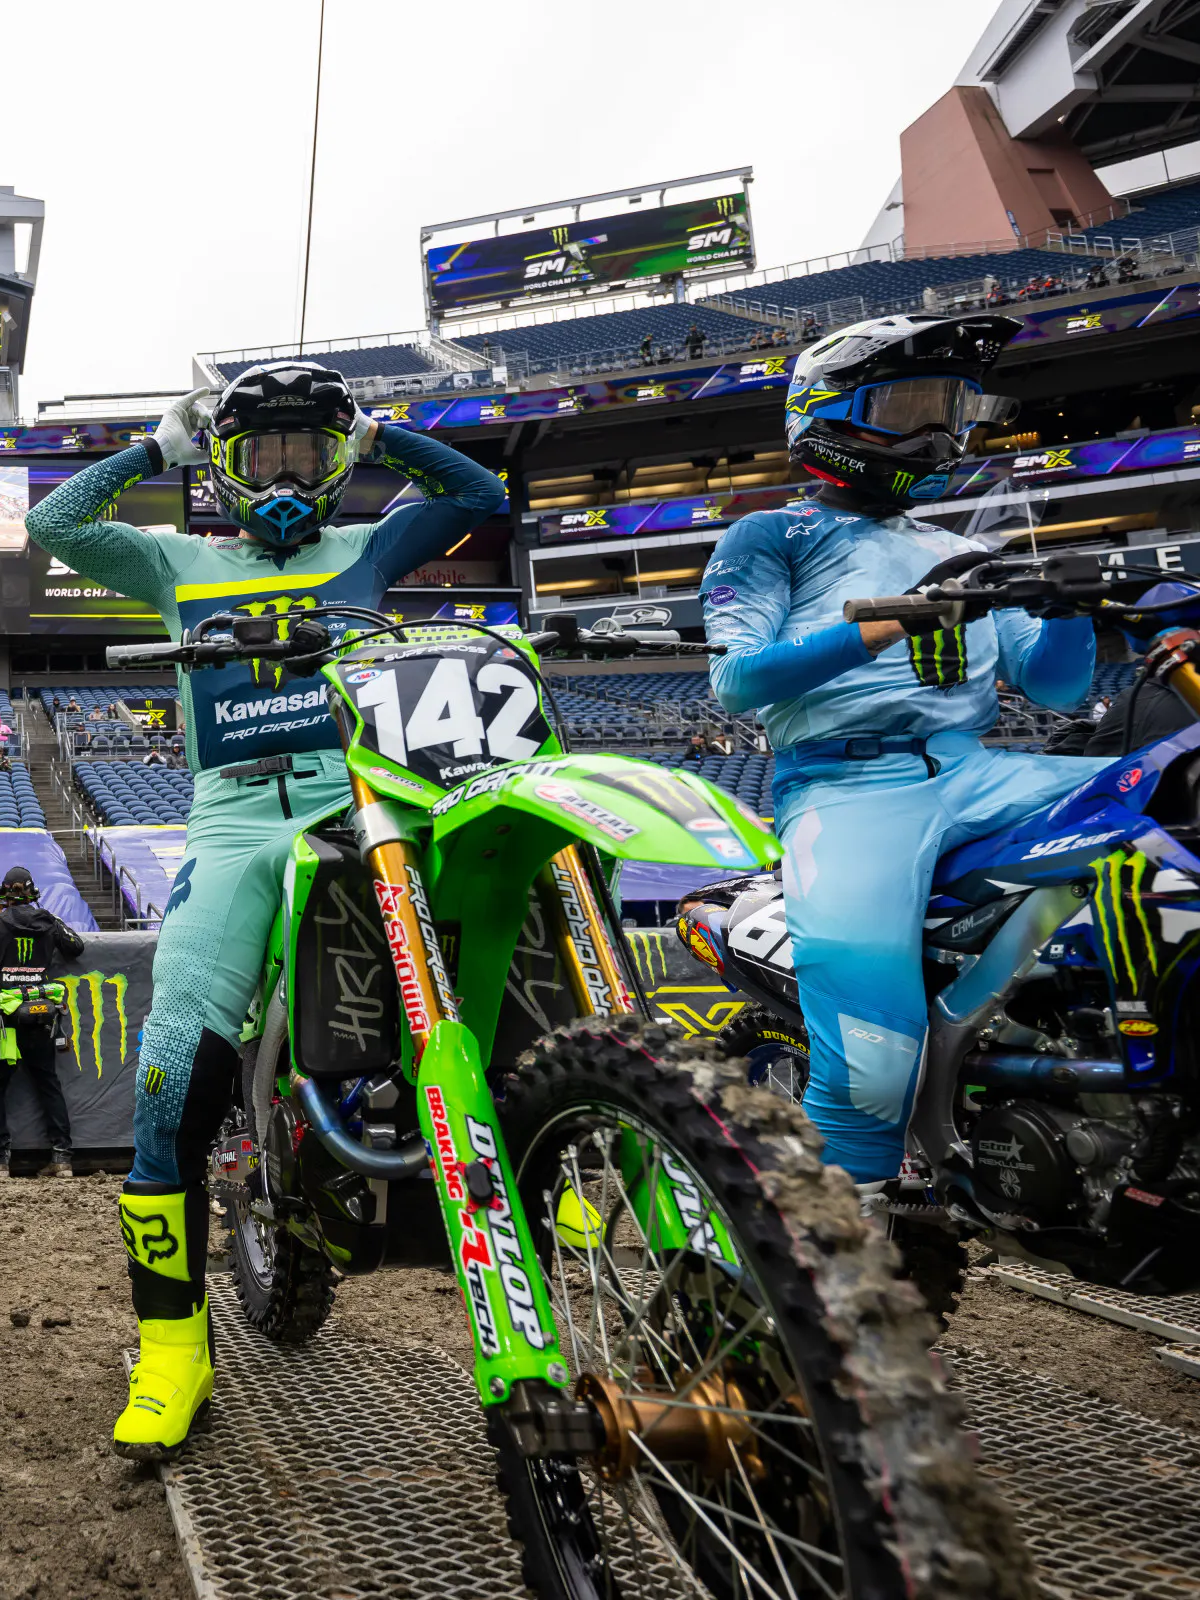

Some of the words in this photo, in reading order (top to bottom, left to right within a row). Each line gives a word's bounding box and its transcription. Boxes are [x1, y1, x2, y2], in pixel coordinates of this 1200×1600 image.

[687, 254, 713, 264] WORLD
[524, 282, 547, 291] WORLD
[1066, 315, 1102, 329] SMX
[740, 360, 786, 375] SMX
[371, 406, 409, 420] SMX
[808, 439, 866, 473] MONSTER
[1012, 449, 1072, 468] SMX
[560, 510, 608, 527] SMX
[45, 588, 80, 597] WORLD
[454, 606, 486, 619] SMX
[214, 684, 329, 725] Kawasak
[357, 658, 542, 767] 142
[222, 728, 255, 742] PRO
[259, 713, 332, 734] CIRCUIT
[404, 864, 433, 921] PRO
[550, 863, 600, 966] CIRCUIT
[383, 919, 431, 1035] SHOWA
[763, 1030, 810, 1055] DUNLO
[424, 1086, 466, 1201] BRAKING
